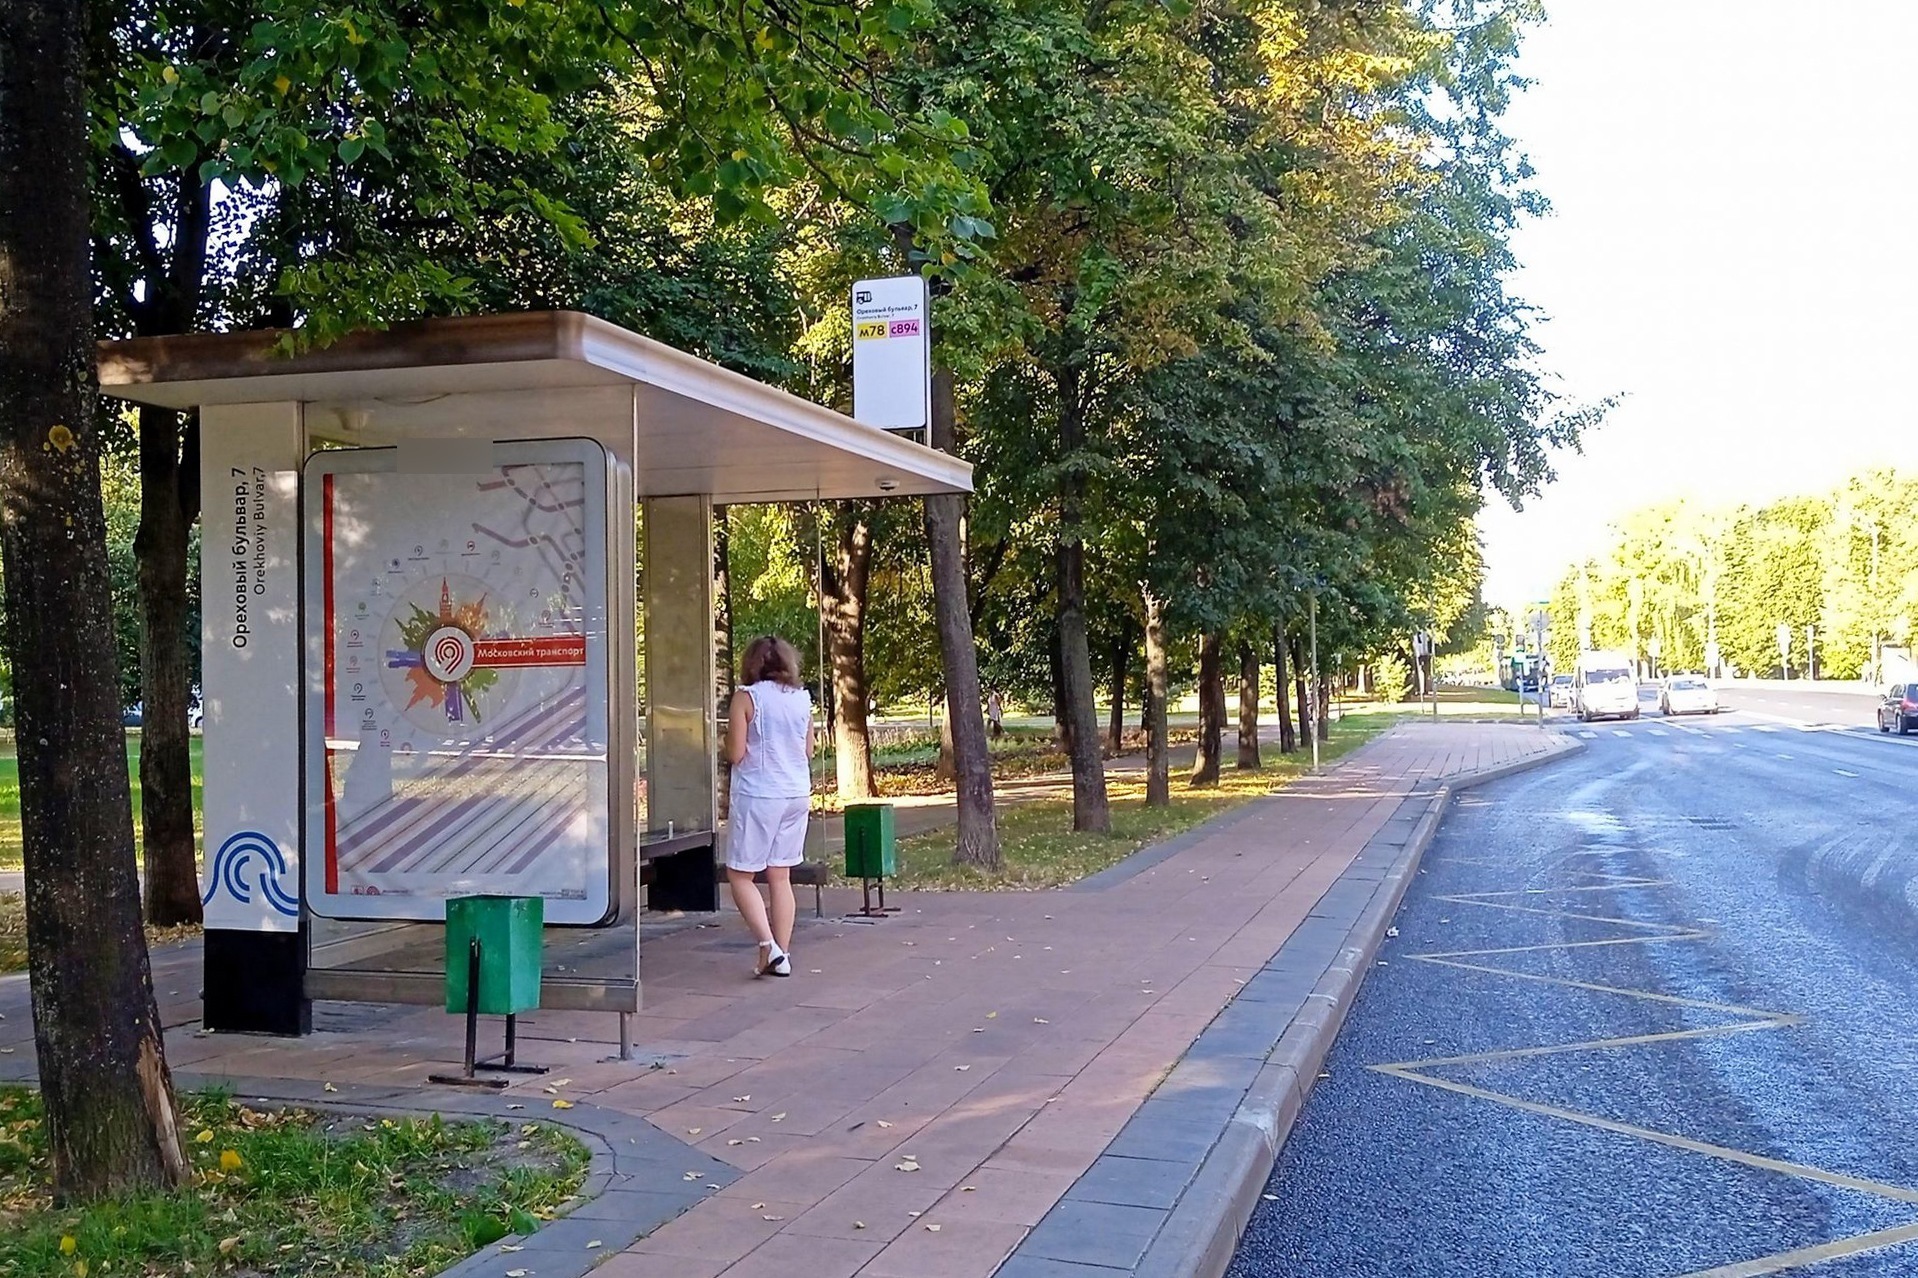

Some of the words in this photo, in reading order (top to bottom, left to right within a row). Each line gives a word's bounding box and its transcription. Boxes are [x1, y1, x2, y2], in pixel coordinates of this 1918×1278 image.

[231, 467, 246, 477] 7
[232, 482, 250, 555] бульвар,
[253, 525, 266, 595] Orekhoviy
[232, 561, 250, 648] Ореховый
[478, 648, 533, 658] Московский
[536, 647, 584, 657] транспорт
